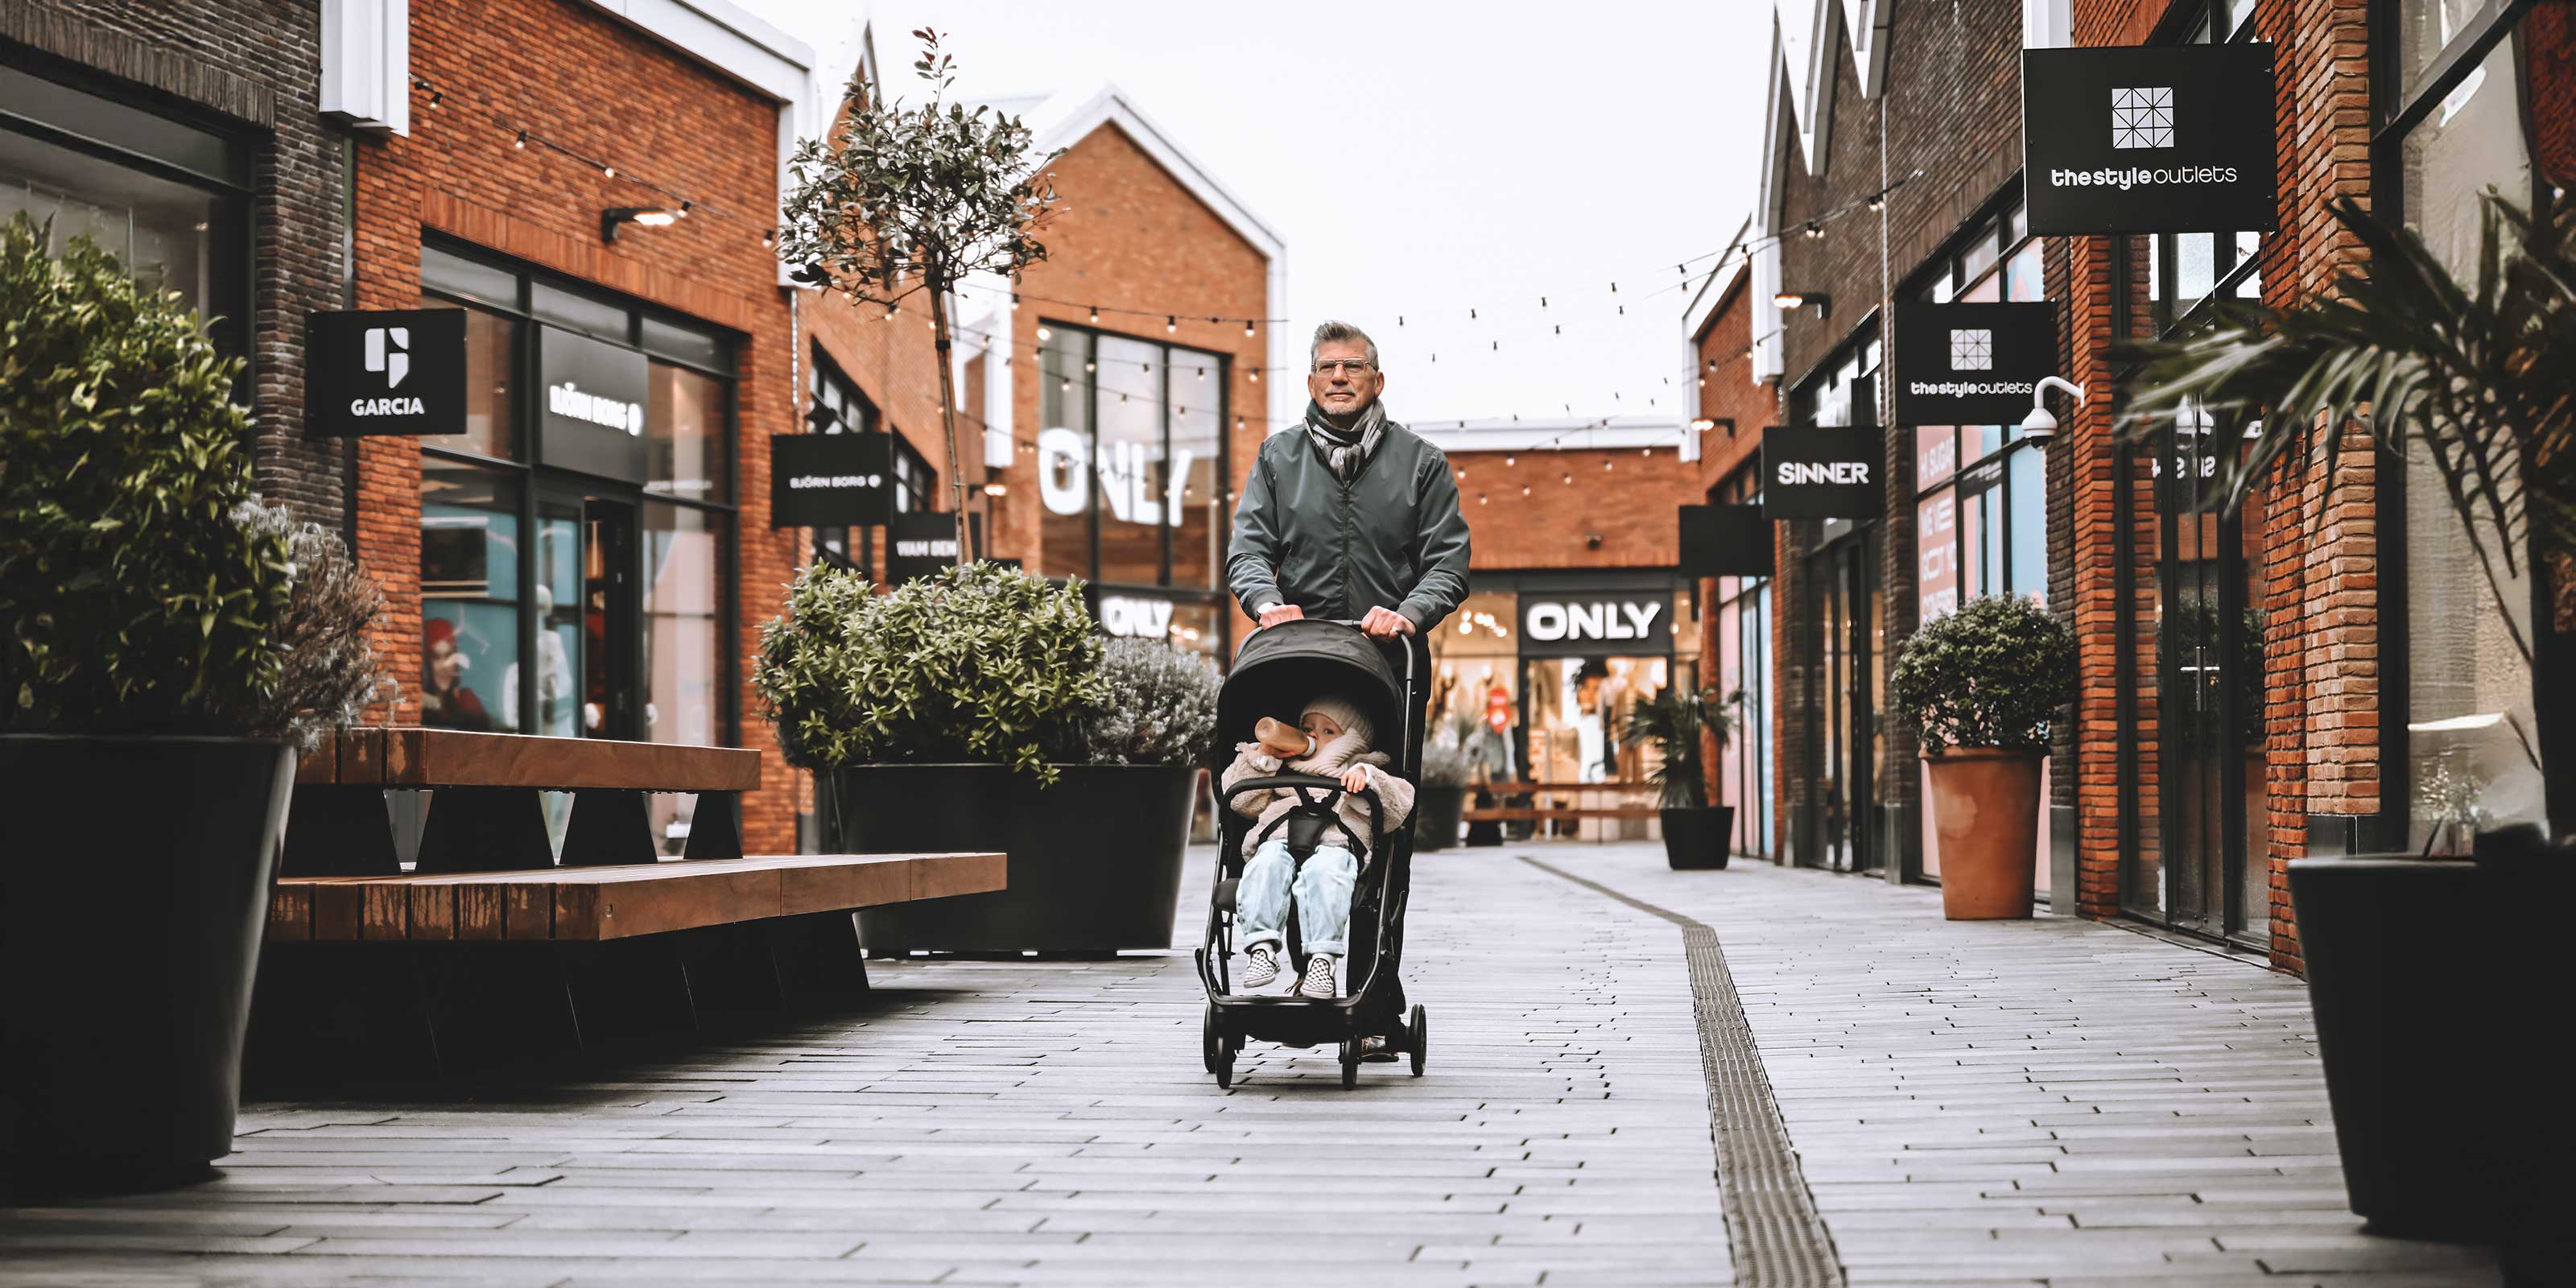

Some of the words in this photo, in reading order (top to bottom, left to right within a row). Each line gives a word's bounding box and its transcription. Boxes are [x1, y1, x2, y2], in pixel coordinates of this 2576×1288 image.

[351, 397, 425, 416] GARCIA
[790, 475, 831, 489] BJÖRN
[832, 476, 866, 488] BORG
[1038, 427, 1193, 527] ONLY
[1777, 462, 1869, 485] SINNER
[1100, 596, 1173, 638] ONLY
[1526, 601, 1662, 641] ONLY
